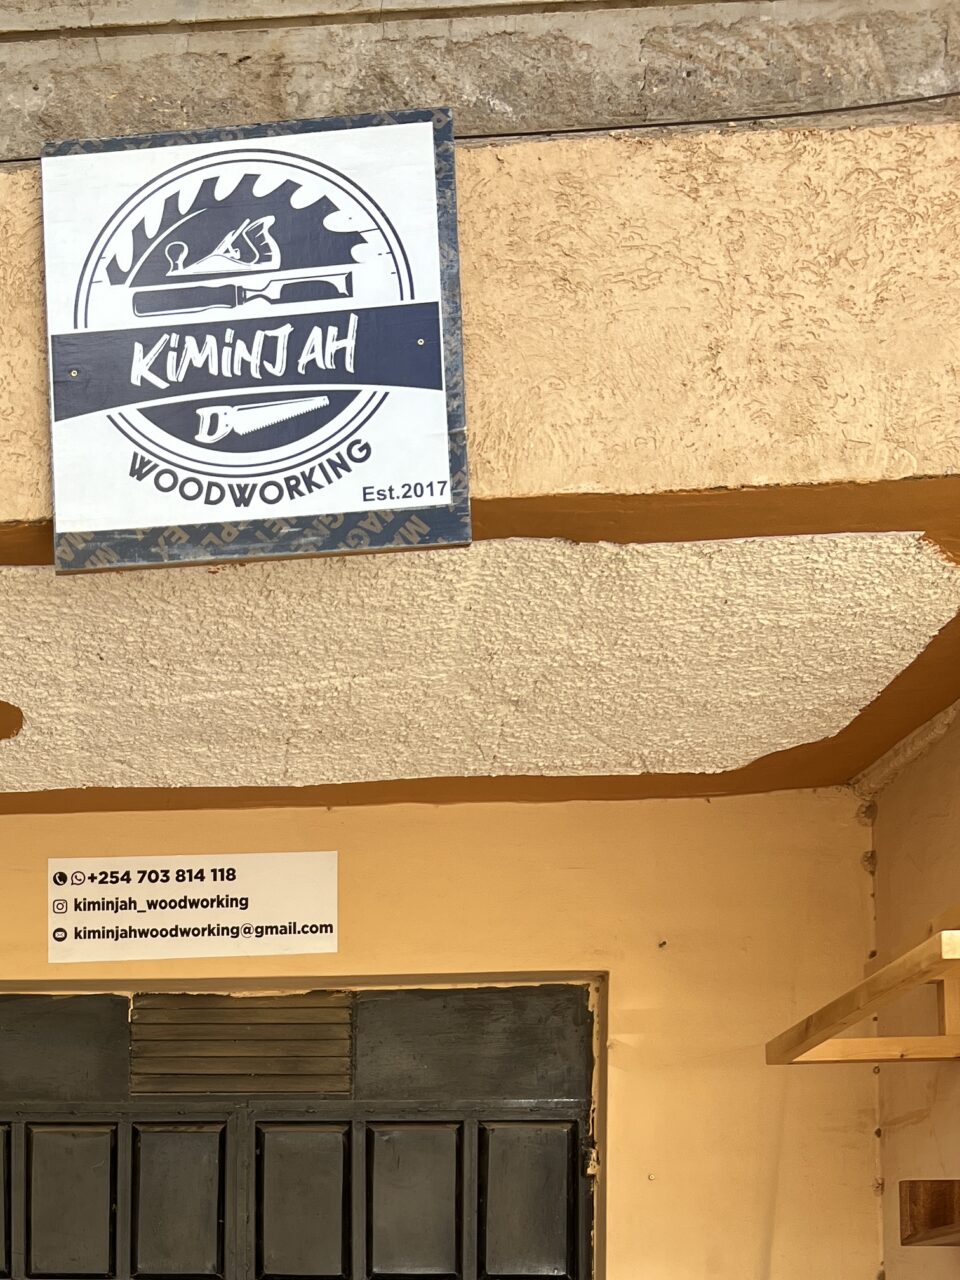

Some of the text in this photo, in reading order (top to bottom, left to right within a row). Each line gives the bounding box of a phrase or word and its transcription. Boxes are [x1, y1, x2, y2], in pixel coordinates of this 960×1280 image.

[129, 438, 372, 508] WOODWORKING
[362, 480, 448, 503] Est.2017
[87, 867, 237, 885] +254 703 814 118
[73, 894, 249, 914] kiminjah_woodworking
[74, 921, 334, 942] kiminjahwoodworking@gmail.com
